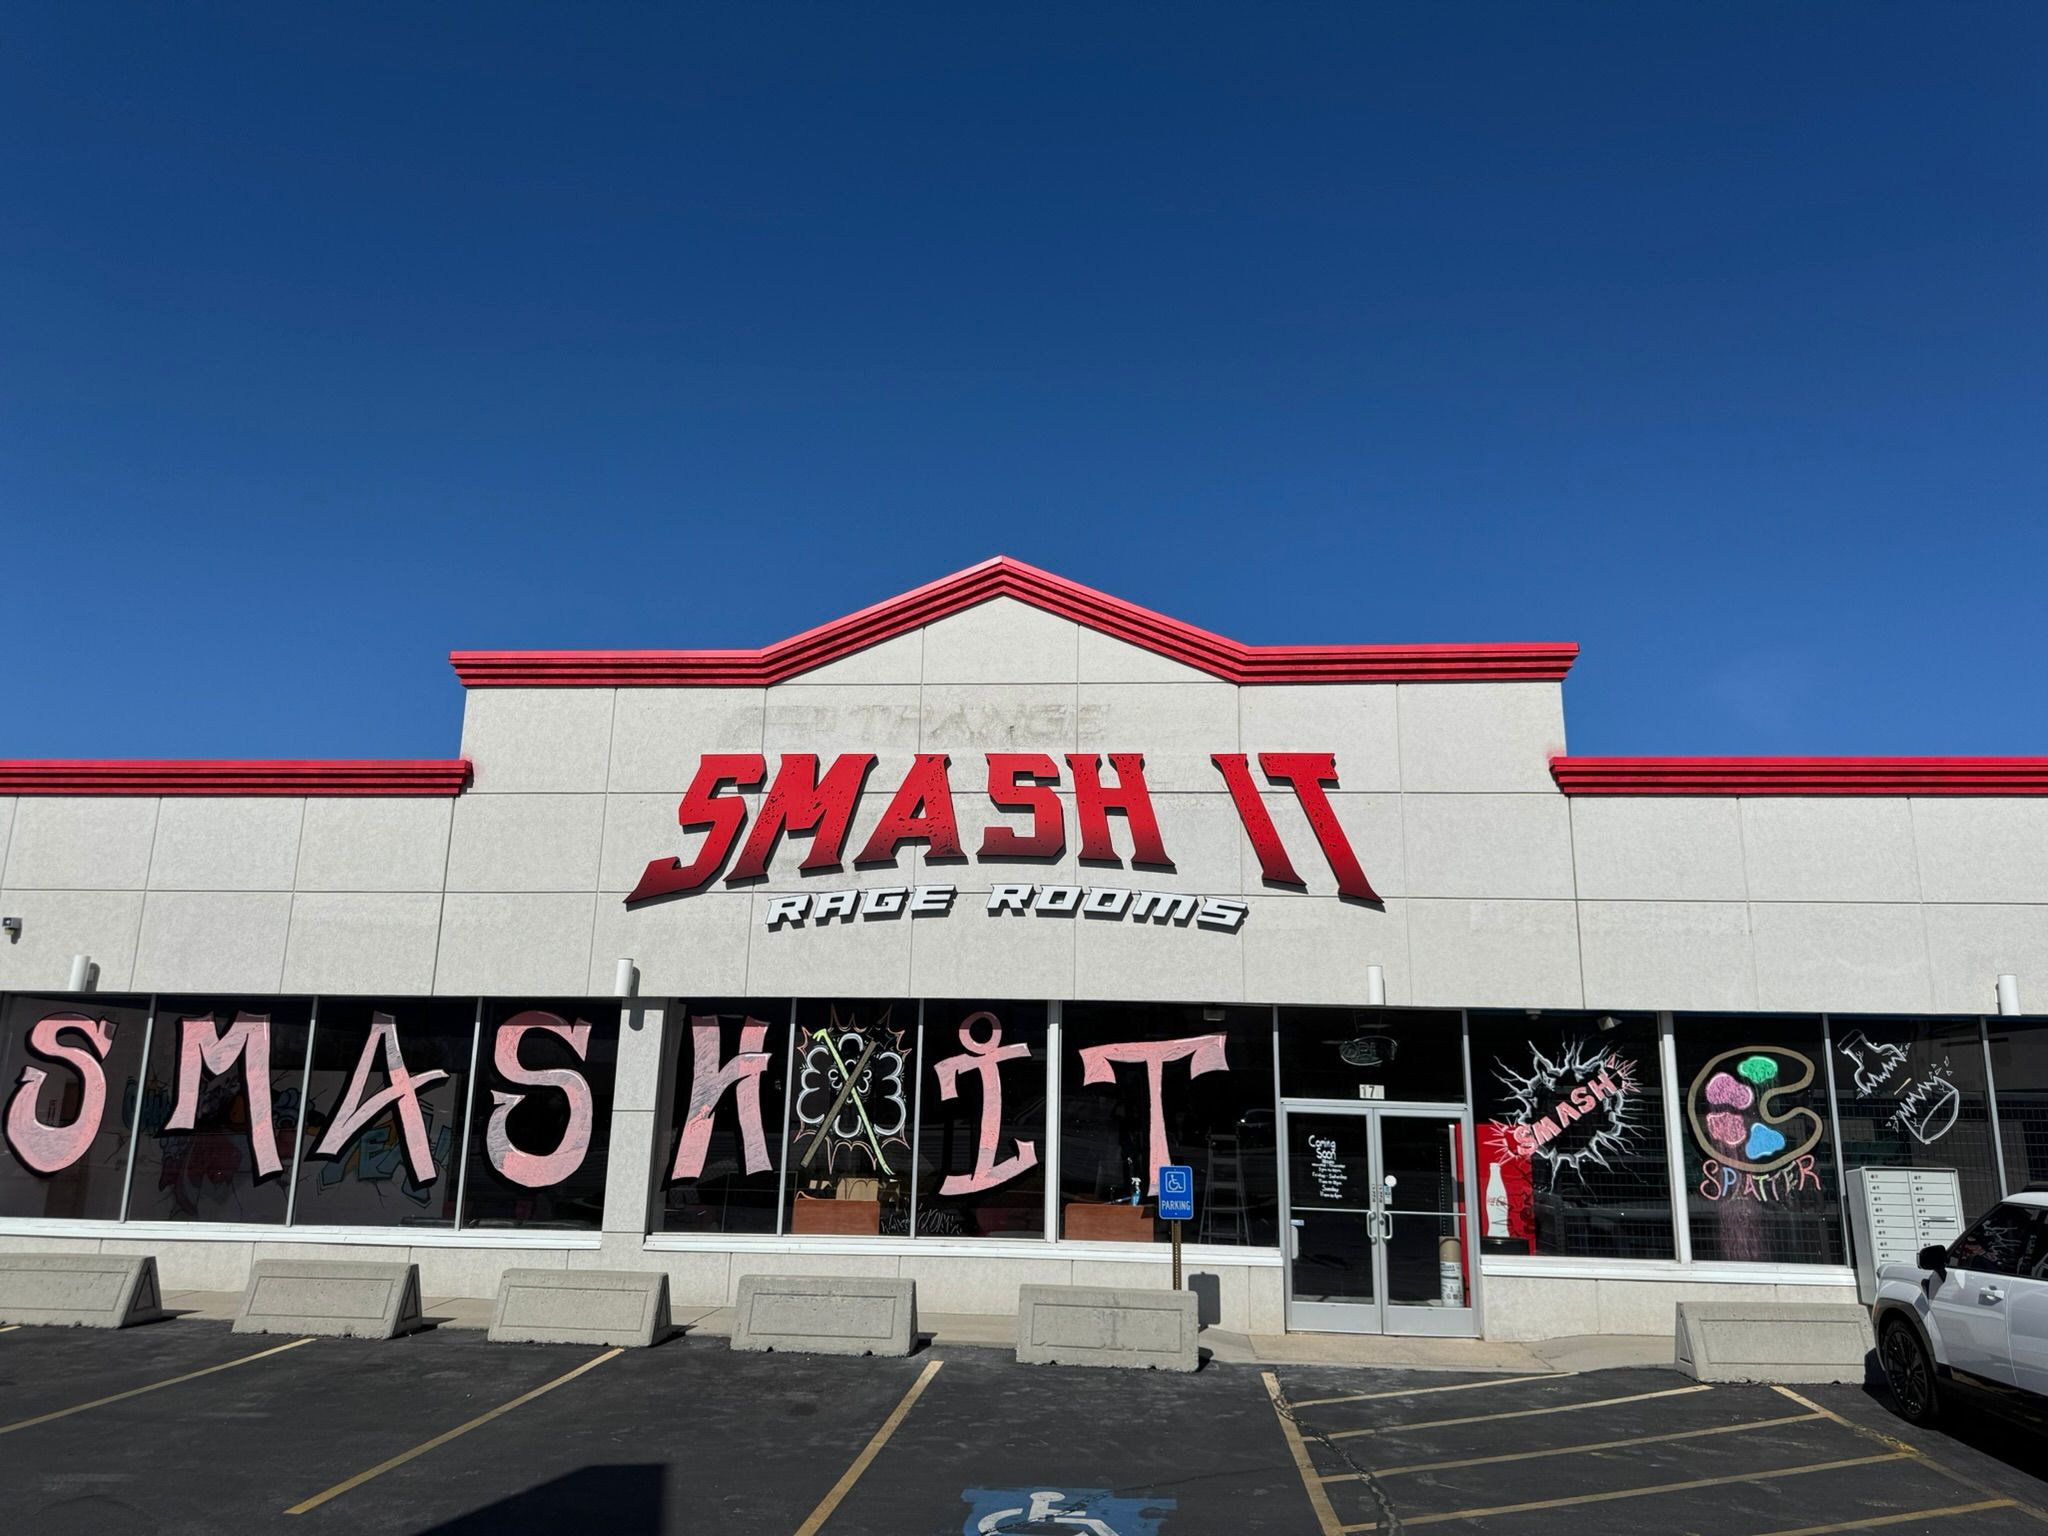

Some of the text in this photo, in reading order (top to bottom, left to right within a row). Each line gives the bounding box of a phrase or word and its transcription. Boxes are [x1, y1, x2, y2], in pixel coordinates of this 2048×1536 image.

[624, 753, 1384, 905] SMASH IT
[764, 884, 1248, 931] RAGE ROOMS
[4, 1010, 774, 1189] SMASH
[1513, 1071, 1618, 1156] SMASH
[1308, 1134, 1337, 1151] Coming
[1316, 1147, 1337, 1160] Soon
[1700, 1154, 1821, 1202] SPATTER
[1161, 1200, 1191, 1211] PARKING
